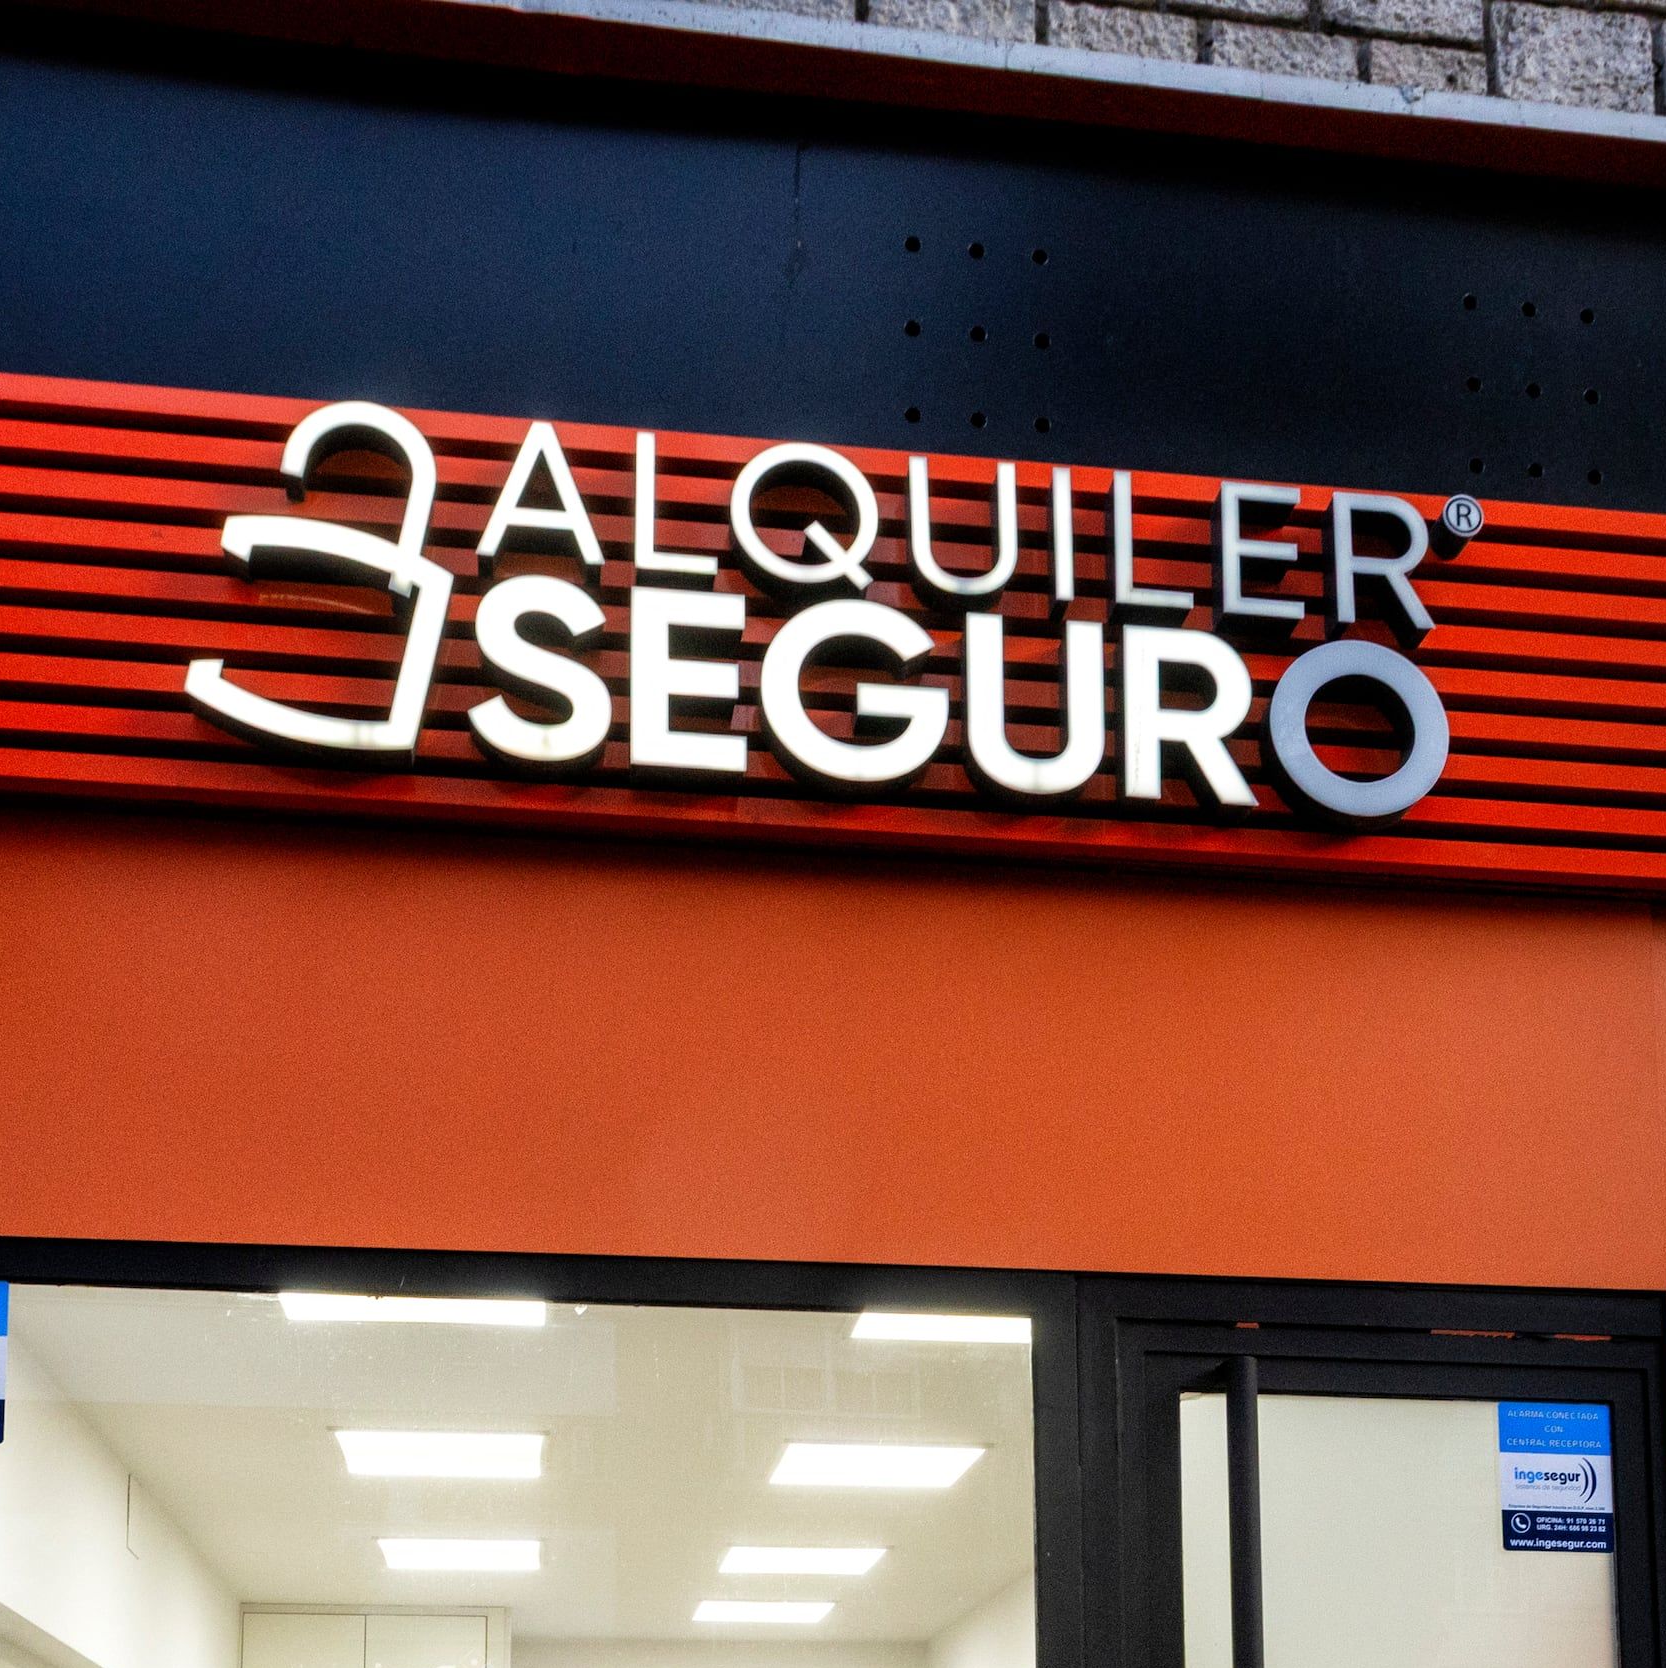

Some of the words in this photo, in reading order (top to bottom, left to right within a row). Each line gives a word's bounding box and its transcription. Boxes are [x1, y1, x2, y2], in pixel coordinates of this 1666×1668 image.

[475, 421, 1435, 632] ALQUILER
[466, 574, 1449, 817] SEGURO
[1507, 1410, 1544, 1418] ALARMA
[1546, 1411, 1599, 1420] CONECTADA
[1544, 1425, 1563, 1433] CON
[1507, 1438, 1546, 1447] CENTRAL
[1549, 1439, 1601, 1448] RECEPTORA
[1514, 1467, 1581, 1485] ingesegur
[1510, 1537, 1607, 1550] www.ingesegur.com
